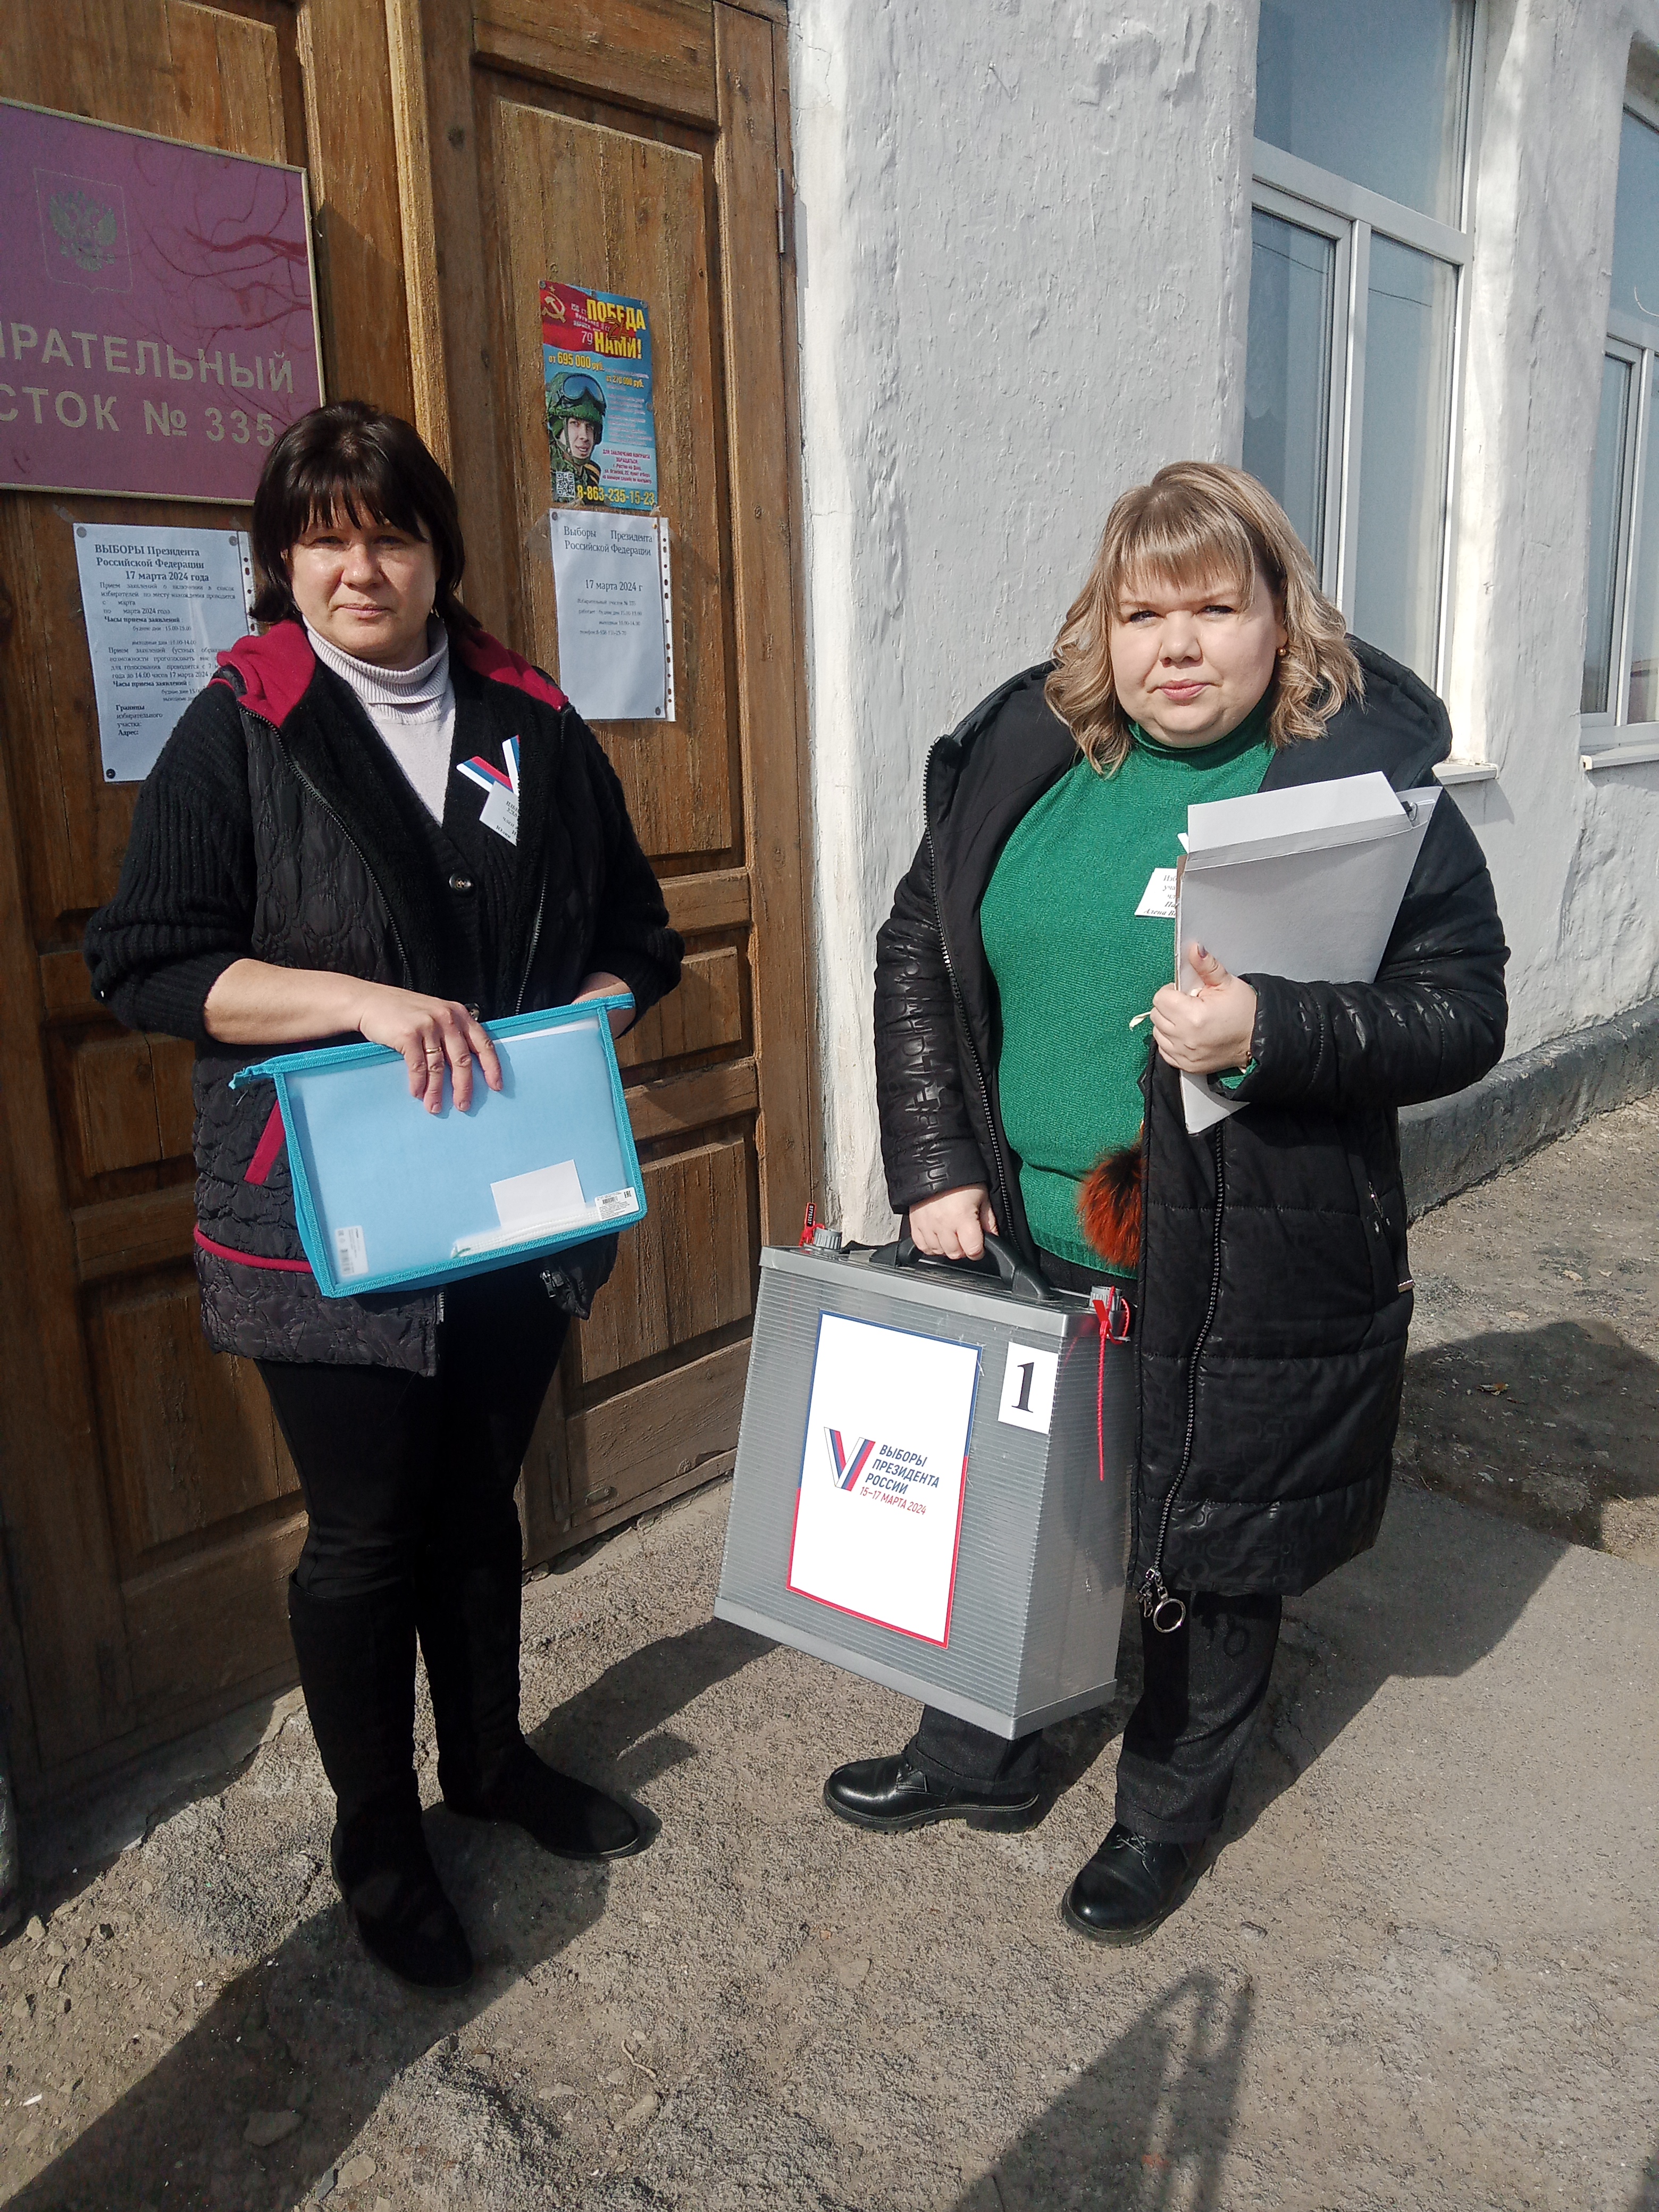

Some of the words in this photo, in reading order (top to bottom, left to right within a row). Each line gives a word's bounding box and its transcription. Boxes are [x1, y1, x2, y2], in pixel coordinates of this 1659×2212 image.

[586, 299, 646, 332] ПОБЕДА
[0, 319, 294, 393] РАТЕЛЬНЫЙ
[594, 331, 642, 359] НАМИ!
[557, 351, 574, 366] 695
[575, 354, 591, 369] 000
[143, 400, 187, 437] №
[205, 407, 276, 447] 335
[564, 526, 596, 539] Выборы
[611, 530, 652, 542] Президента
[95, 544, 145, 555] ВЫБОРЫ
[147, 546, 200, 557] Президента
[565, 540, 609, 552] Российской
[611, 543, 651, 556] Федерации
[96, 557, 153, 567] Российской
[155, 559, 204, 570] Федерации
[126, 571, 136, 580] 17
[138, 573, 167, 582] марта
[169, 572, 188, 581] 2024
[585, 579, 594, 589] 17
[596, 582, 618, 592] марта
[619, 581, 636, 591] 2024
[1011, 1361, 1035, 1413] 1
[879, 1444, 928, 1467] ВЫБОРЫ
[865, 1472, 909, 1495] РОССИИ
[872, 1459, 940, 1488] ПРЕЗИДЕНТА
[880, 1493, 907, 1510] МАРТА
[907, 1501, 927, 1515] 2024
